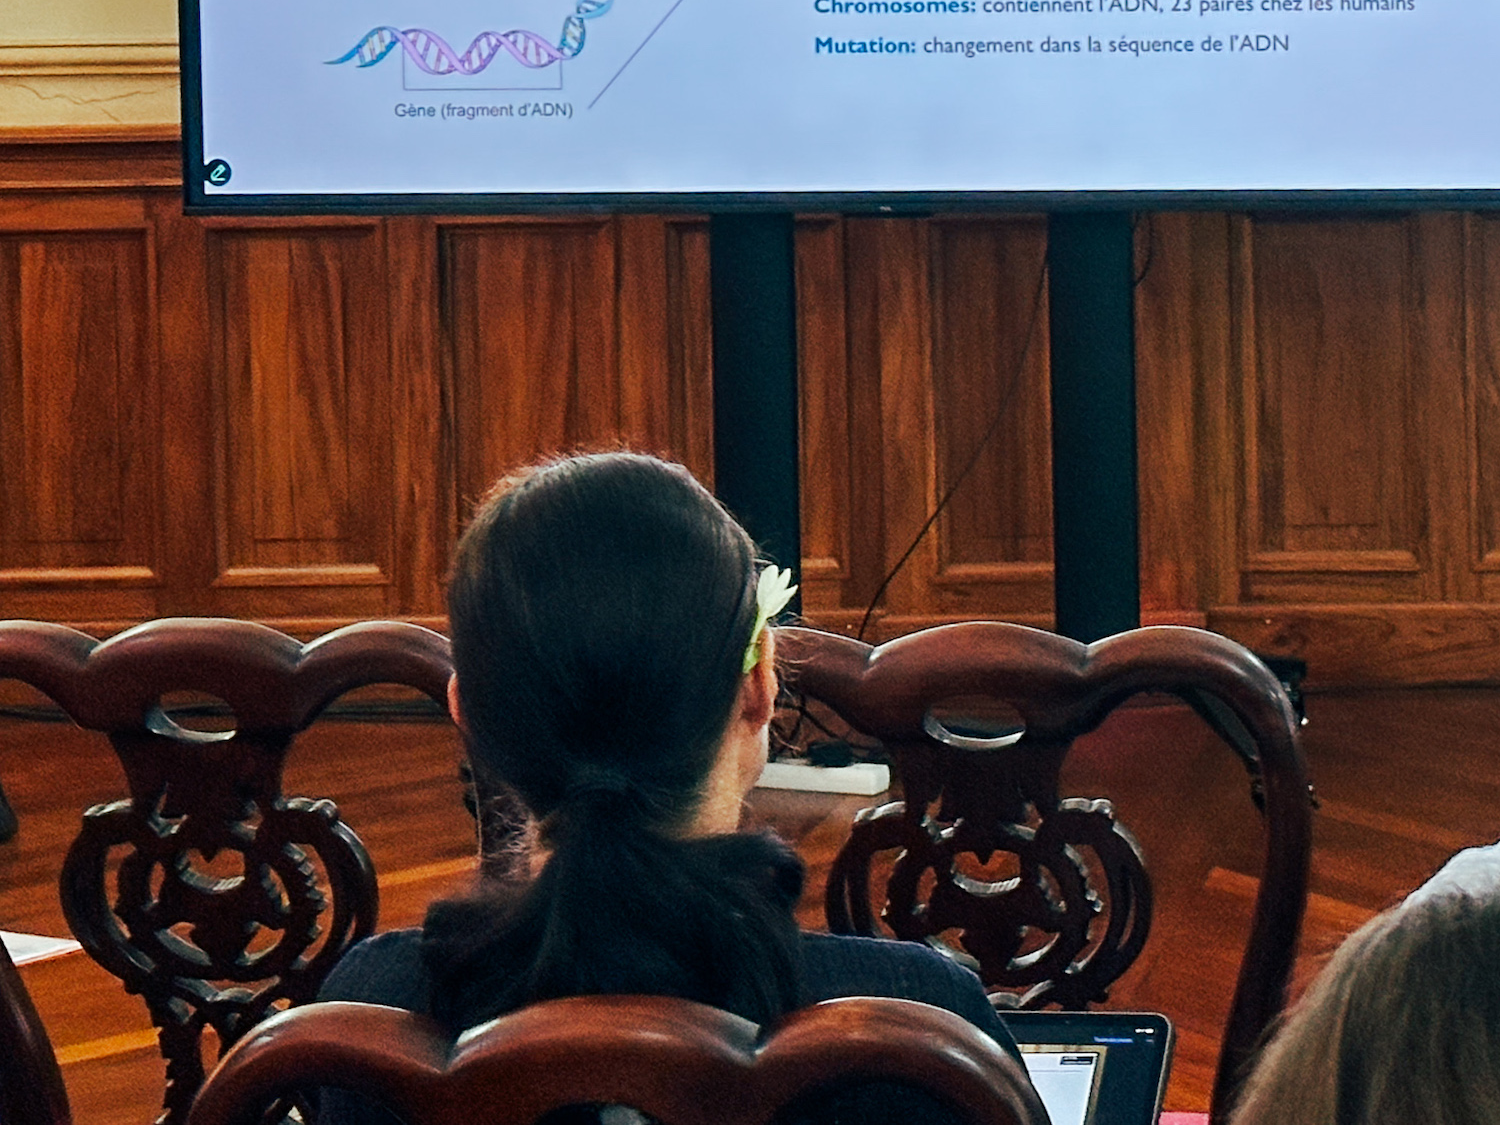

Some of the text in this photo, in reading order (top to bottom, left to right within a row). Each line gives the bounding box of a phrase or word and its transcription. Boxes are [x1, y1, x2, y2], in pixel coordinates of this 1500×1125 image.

[815, 36, 916, 54] Mutation:
[923, 36, 1033, 58] changement
[1040, 36, 1081, 53] dans
[1088, 35, 1102, 52] la
[1108, 34, 1194, 57] séquence
[1201, 35, 1223, 52] de
[394, 103, 436, 117] Gène
[441, 103, 514, 120] (fragment
